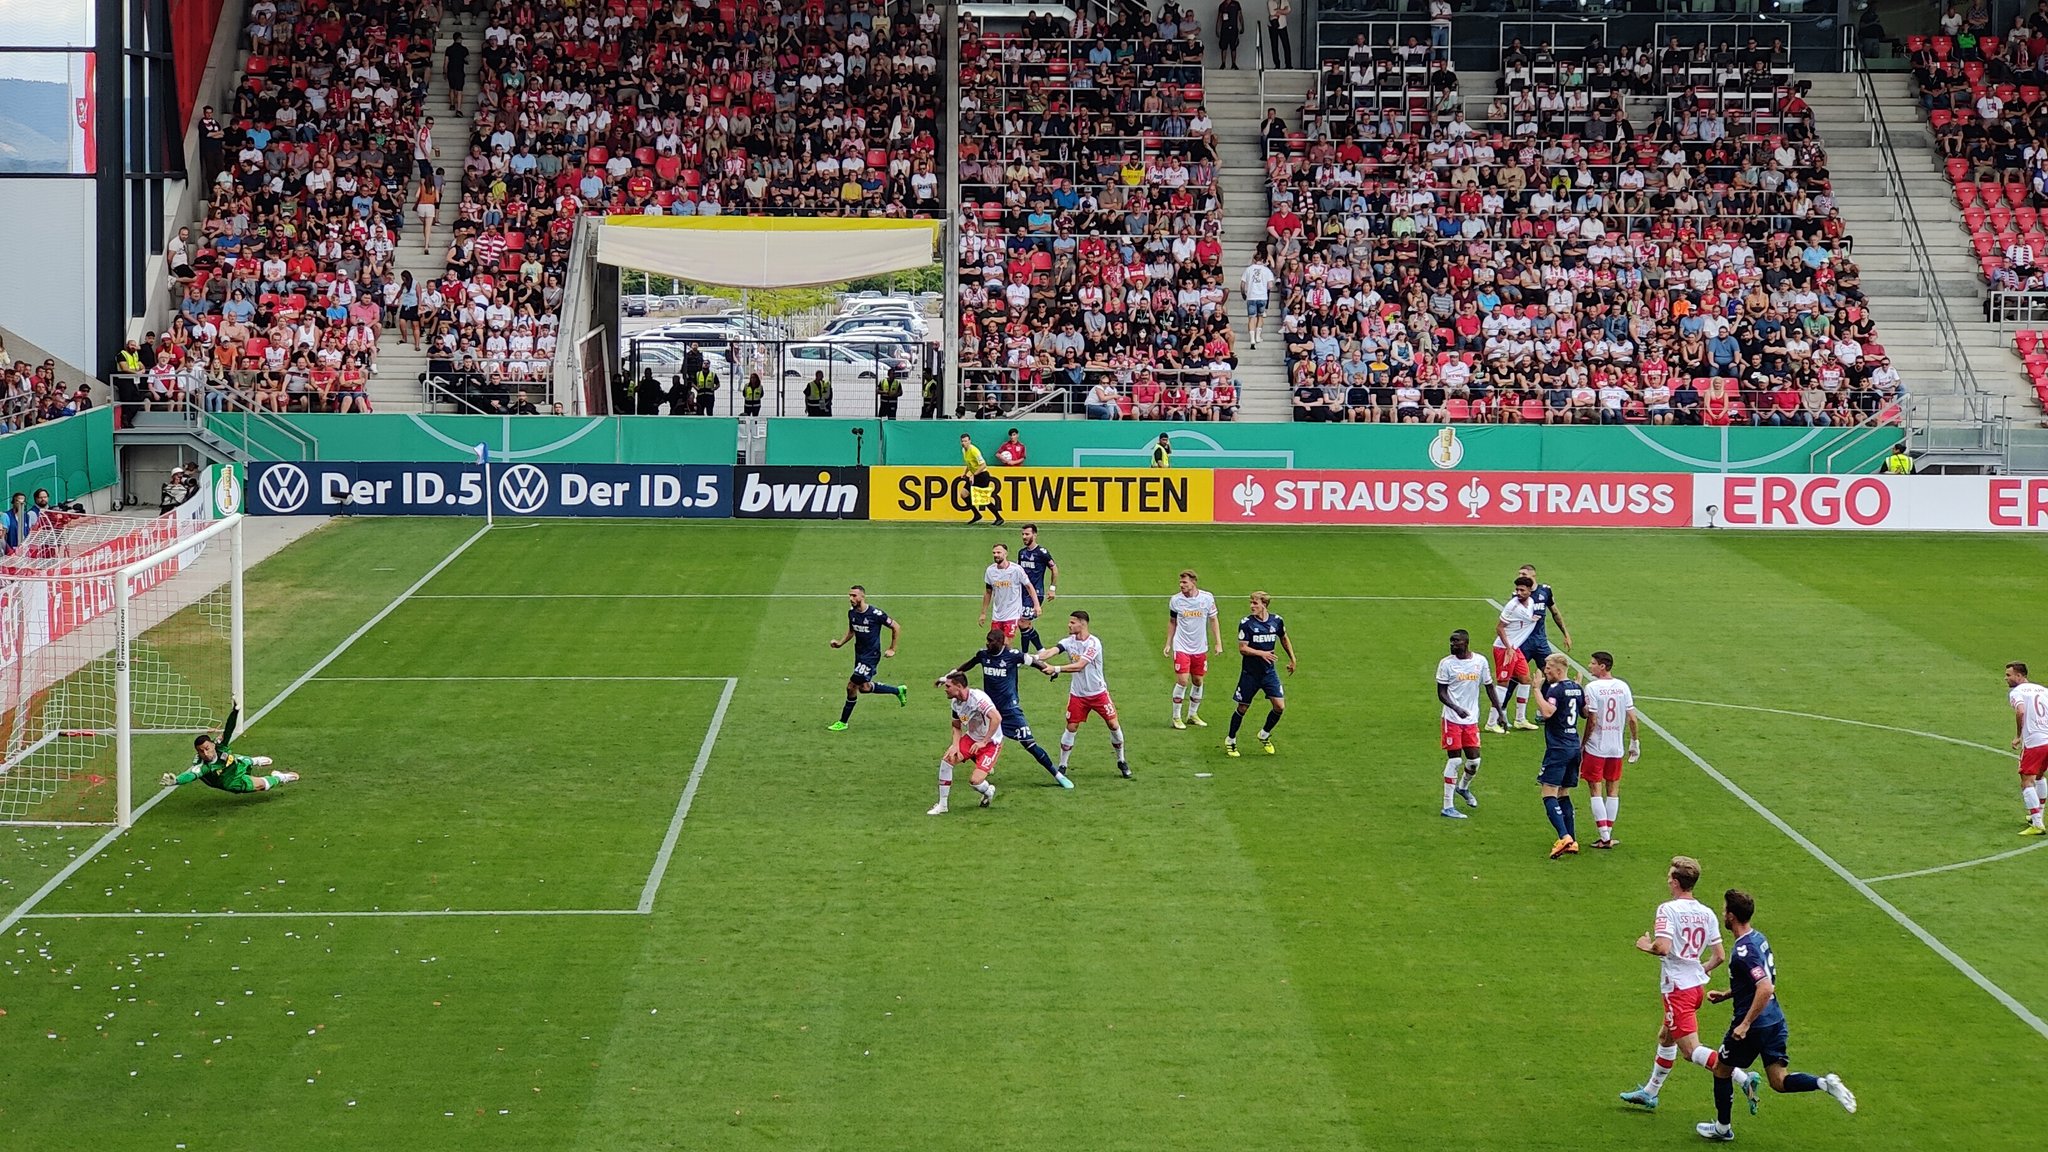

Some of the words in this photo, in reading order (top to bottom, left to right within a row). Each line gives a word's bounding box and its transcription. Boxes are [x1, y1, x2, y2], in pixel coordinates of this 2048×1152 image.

[321, 472, 392, 504] Der
[402, 472, 482, 505] ID.5
[560, 473, 629, 506] Der
[640, 474, 718, 507] ID.5
[740, 471, 859, 512] bwin
[1274, 480, 1449, 511] STRAUSS
[1500, 483, 1675, 514] STRAUSS
[1724, 476, 1891, 526] ERGO
[1252, 634, 1276, 643] REWE
[983, 666, 1006, 677] REWE
[1567, 698, 1577, 726] 3
[1605, 697, 1616, 722] 8
[2034, 694, 2045, 718] 6
[1681, 927, 1706, 958] 29
